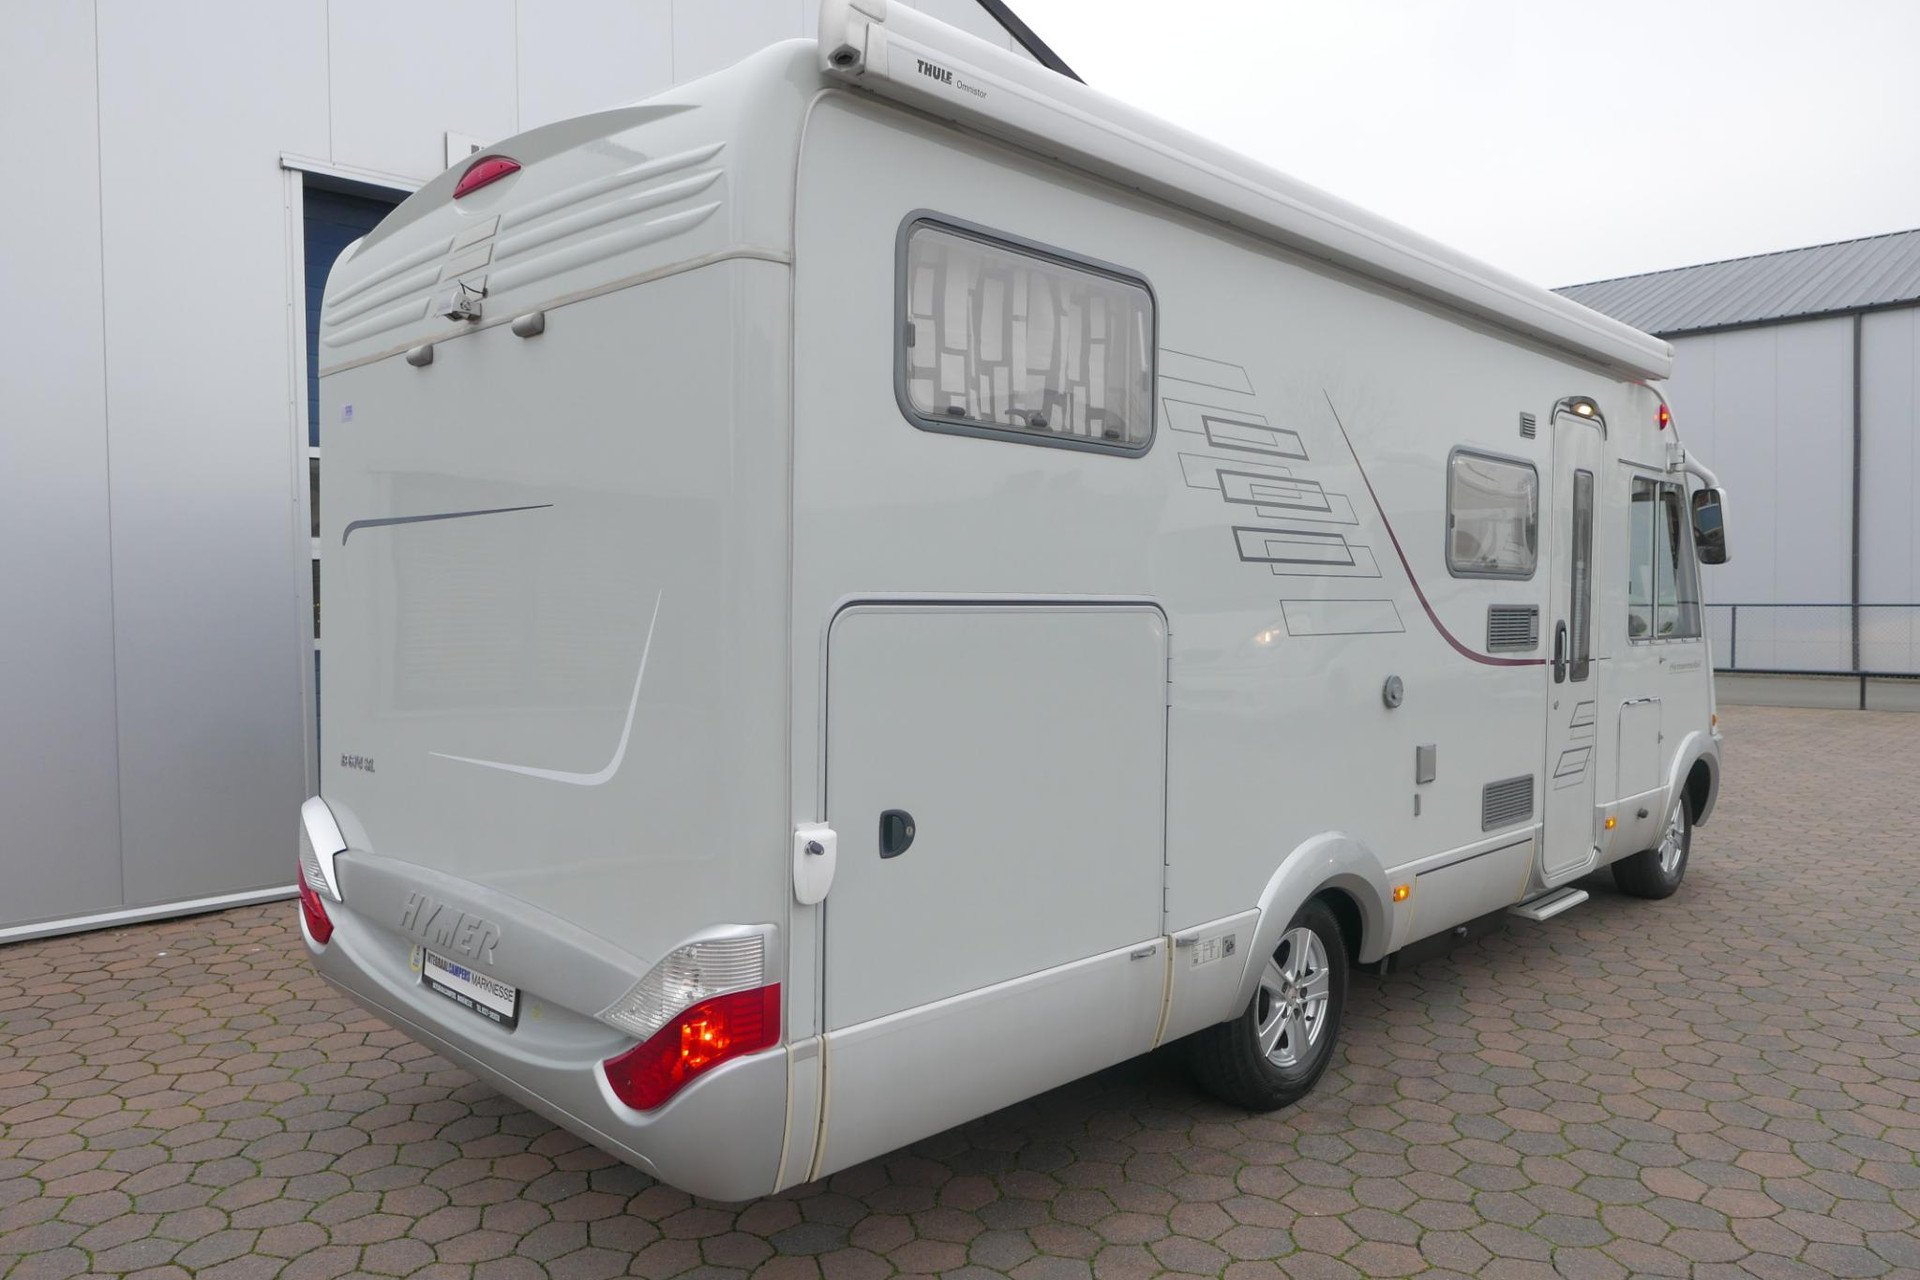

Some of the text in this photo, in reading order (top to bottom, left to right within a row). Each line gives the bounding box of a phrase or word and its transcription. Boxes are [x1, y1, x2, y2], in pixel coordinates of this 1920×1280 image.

[916, 59, 987, 99] THULE Omnistor
[401, 890, 501, 965] HYMER
[471, 975, 514, 1003] MARKNESSE
